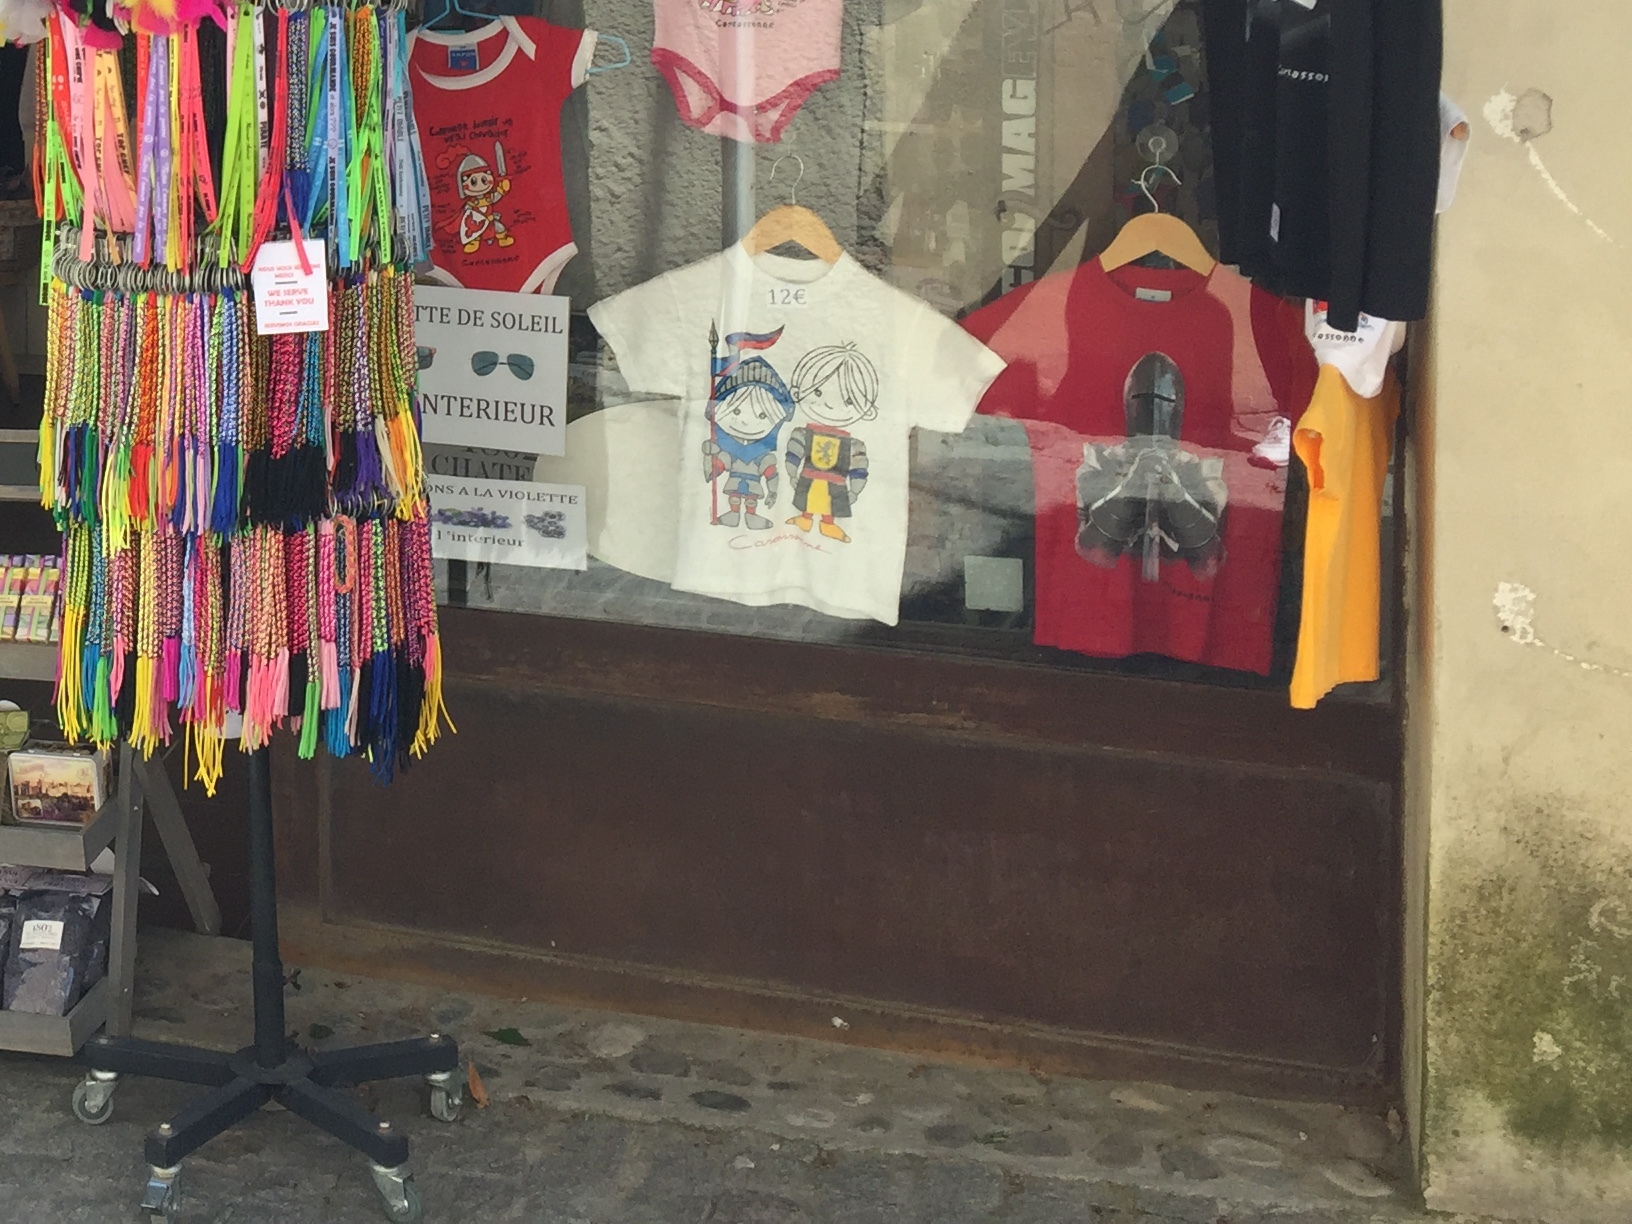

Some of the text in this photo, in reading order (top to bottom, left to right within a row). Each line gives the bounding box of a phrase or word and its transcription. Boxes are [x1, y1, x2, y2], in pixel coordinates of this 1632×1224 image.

[260, 121, 268, 148] PIRATE
[768, 288, 807, 305] 12€
[457, 308, 484, 327] DE
[490, 311, 564, 334] SOLEIL
[422, 393, 556, 427] NTERIEUR
[459, 486, 469, 496] A
[474, 487, 493, 498] LA
[498, 488, 579, 505] VIOLETTE
